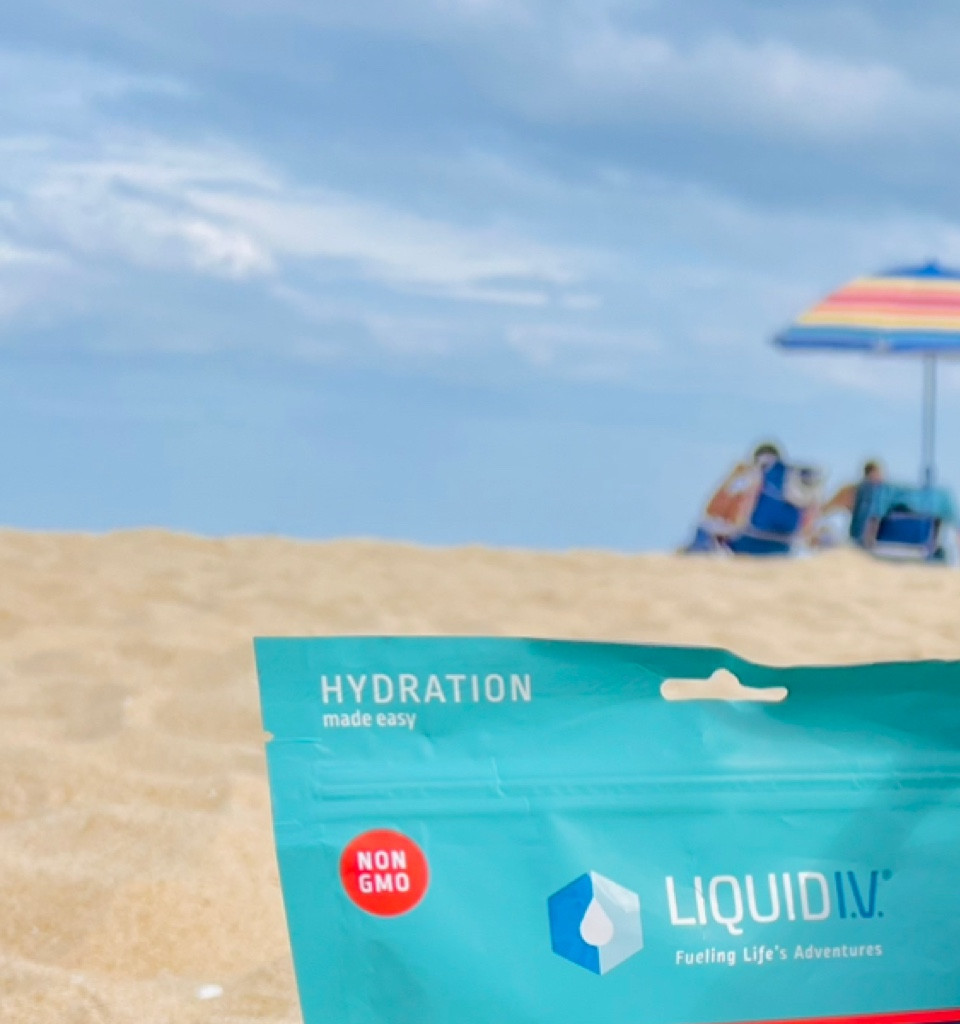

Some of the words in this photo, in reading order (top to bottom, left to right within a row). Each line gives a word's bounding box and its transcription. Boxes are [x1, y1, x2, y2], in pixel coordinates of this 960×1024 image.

[320, 673, 533, 704] HYDRATION
[322, 709, 373, 728] made
[376, 712, 417, 730] easy
[357, 849, 407, 871] NON
[358, 872, 410, 894] GMO
[675, 948, 737, 967] Fueling
[743, 944, 788, 965] Life's
[793, 943, 884, 961] Adventures
